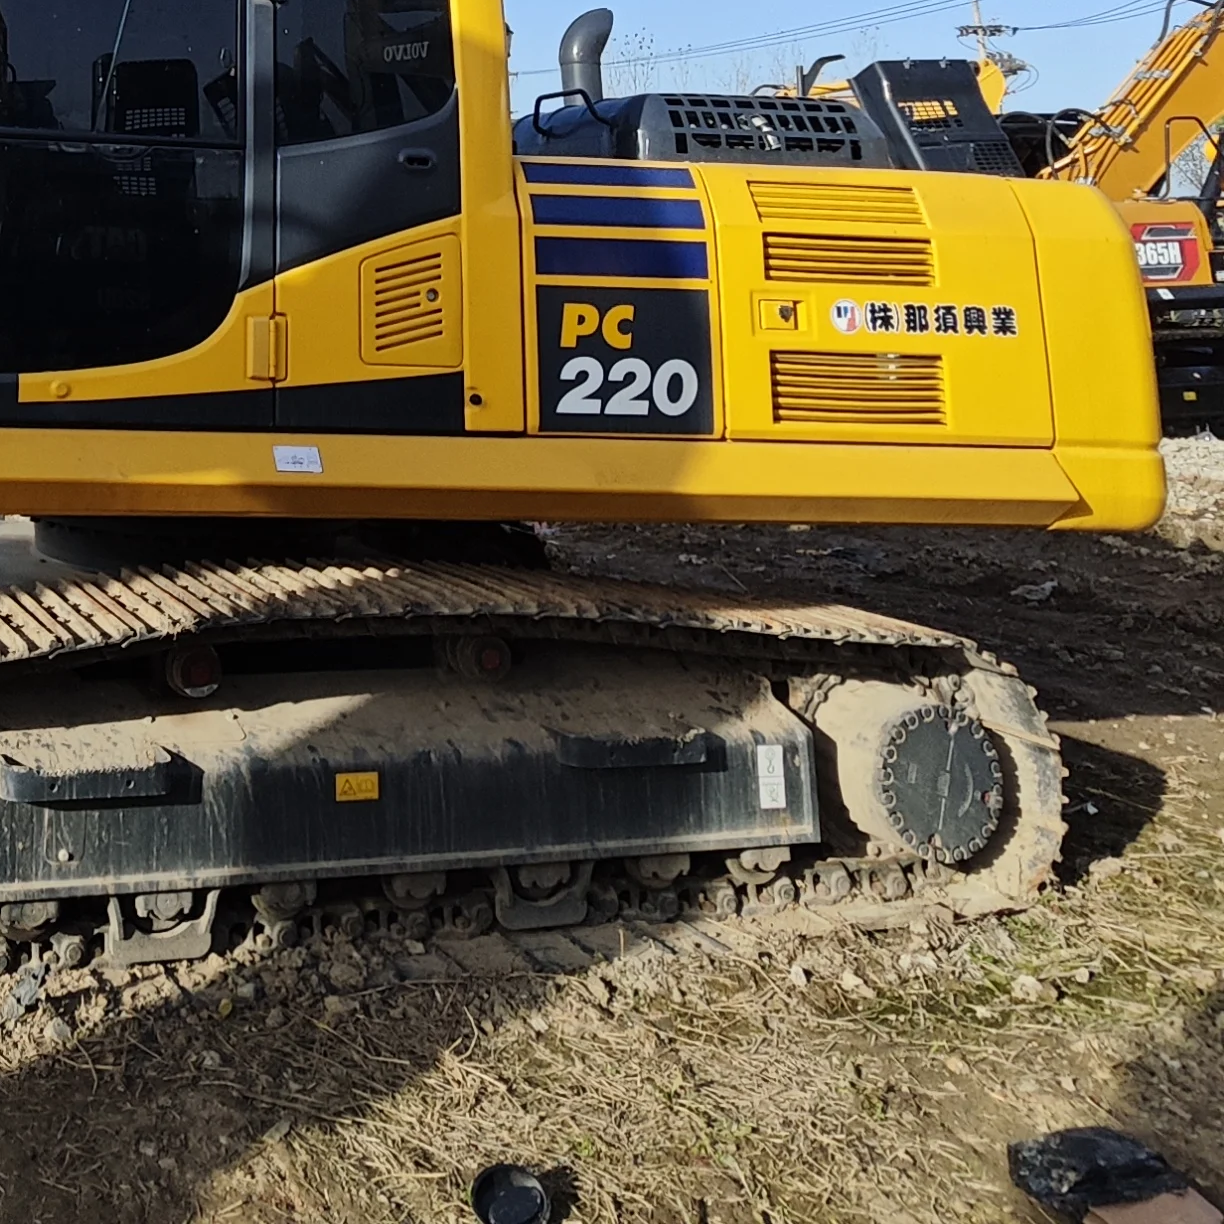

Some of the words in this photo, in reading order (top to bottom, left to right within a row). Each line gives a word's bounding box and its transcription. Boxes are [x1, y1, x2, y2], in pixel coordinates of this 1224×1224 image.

[1135, 241, 1182, 266] 365H
[560, 302, 635, 350] PC
[556, 356, 699, 417] 220
